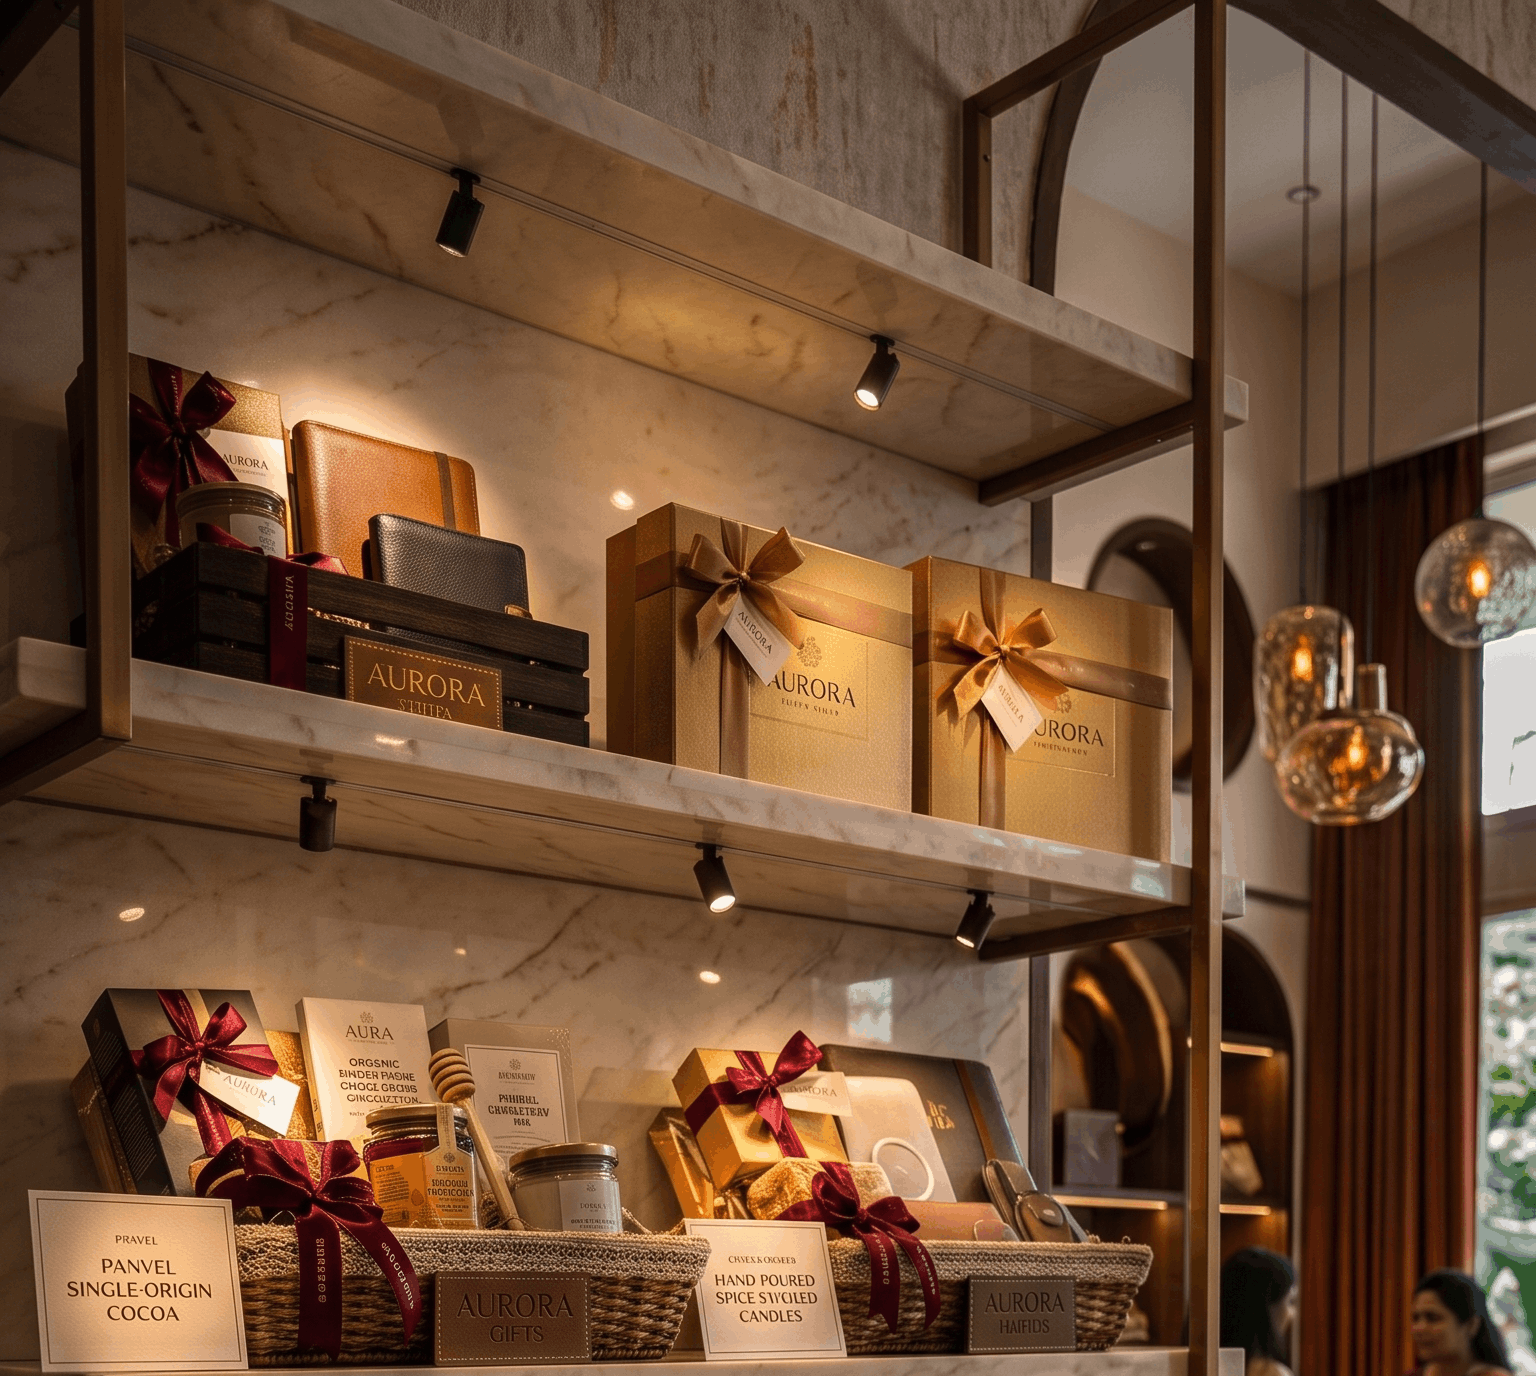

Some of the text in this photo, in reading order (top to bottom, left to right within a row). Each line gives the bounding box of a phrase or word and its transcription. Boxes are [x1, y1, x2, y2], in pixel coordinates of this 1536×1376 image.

[222, 453, 269, 471] AURORA
[367, 662, 486, 708] AURORA
[767, 670, 856, 708] AURORA
[1034, 717, 1104, 748] URORA
[345, 1025, 394, 1041] AURA
[115, 1234, 158, 1246] PRAVEL
[101, 1258, 177, 1275] PANVEL
[714, 1273, 816, 1287] HAND POURED
[66, 1281, 213, 1299] SINGLE-ORIGIN
[715, 1291, 756, 1305] SPICE
[457, 1292, 575, 1318] AURORA
[984, 1291, 1065, 1313] AURORA
[106, 1305, 180, 1322] COCOA
[739, 1309, 804, 1323] CANDLES
[489, 1325, 545, 1343] GIFTS
